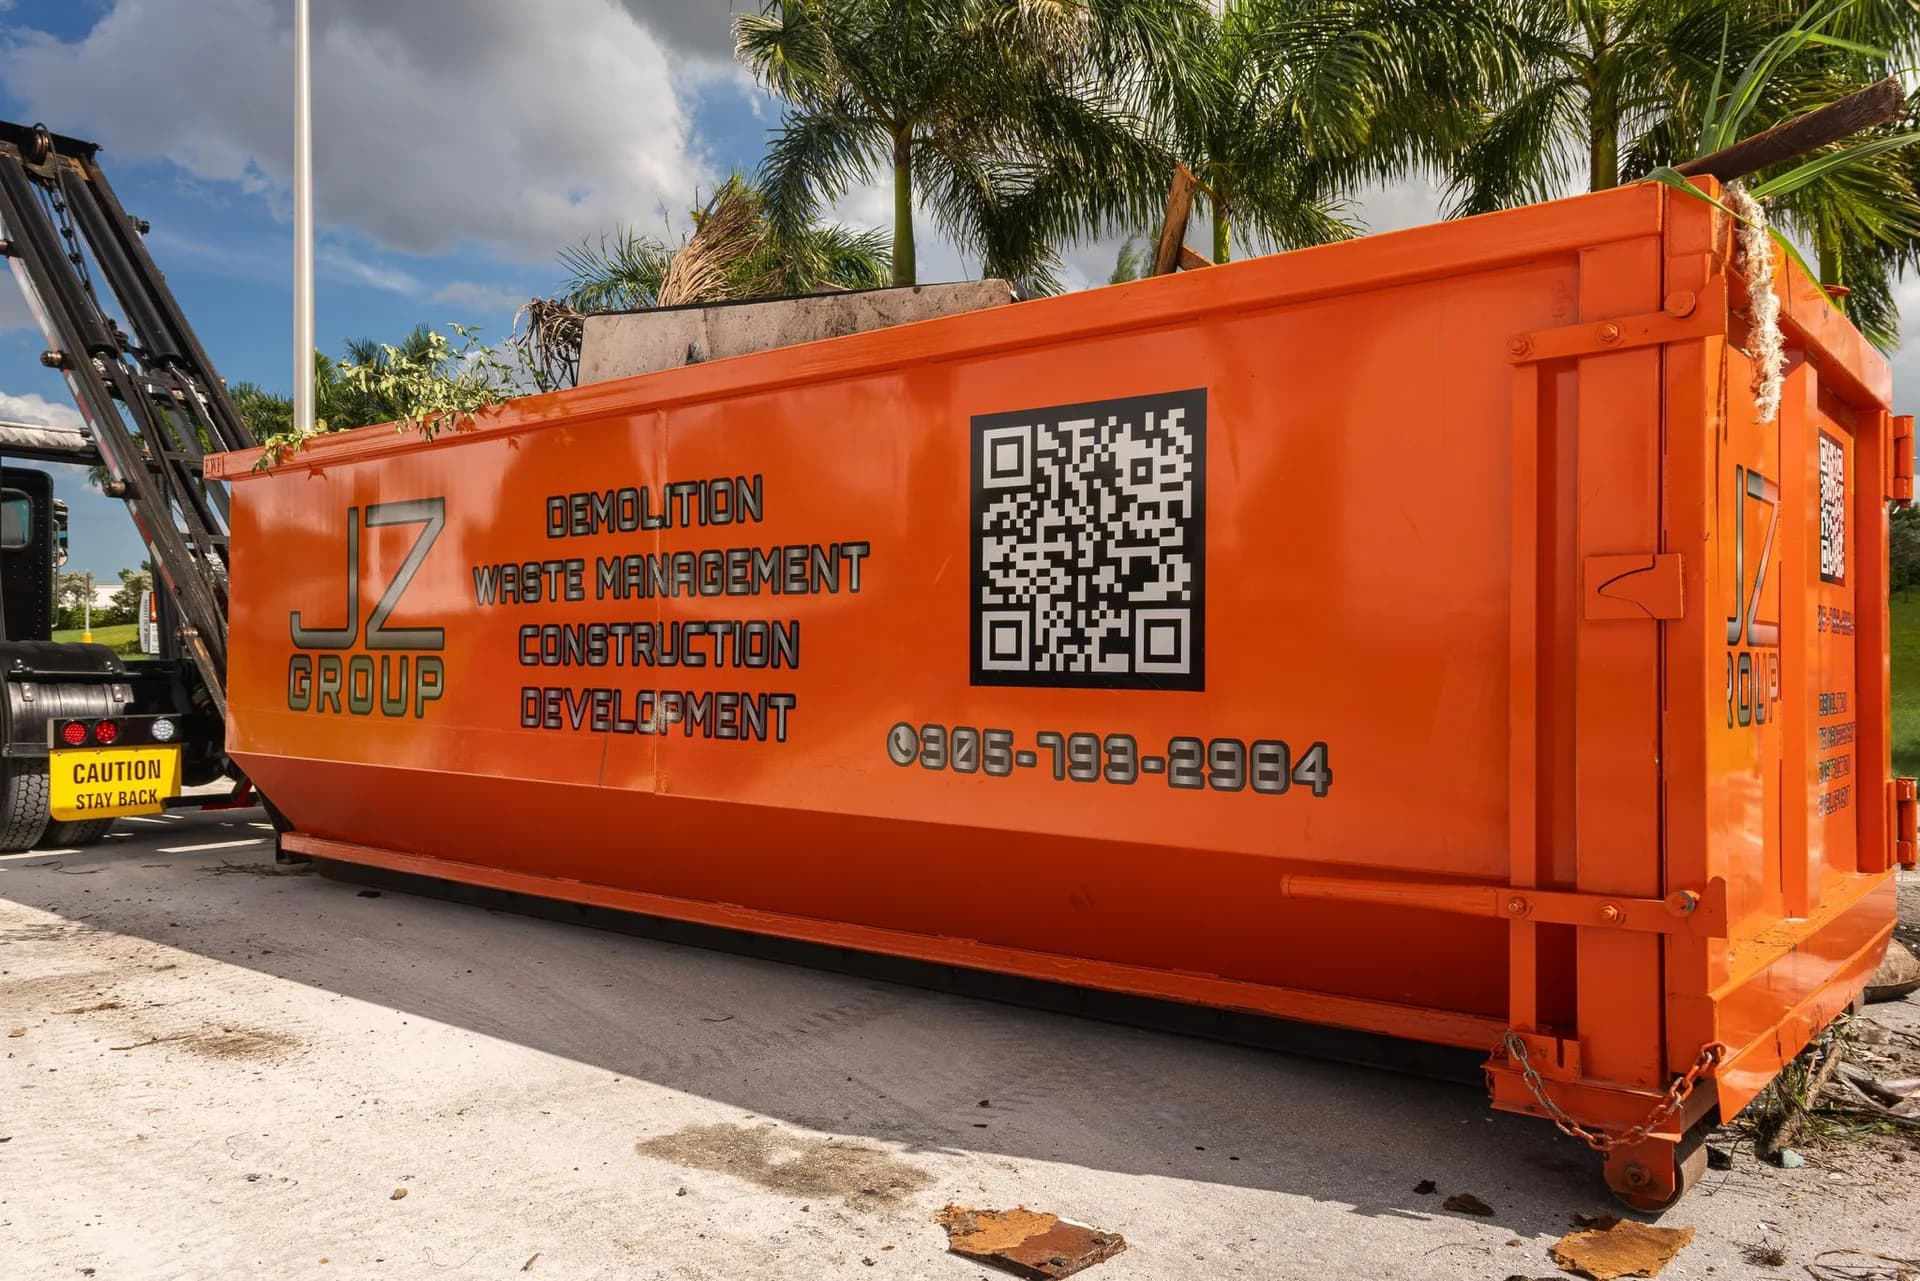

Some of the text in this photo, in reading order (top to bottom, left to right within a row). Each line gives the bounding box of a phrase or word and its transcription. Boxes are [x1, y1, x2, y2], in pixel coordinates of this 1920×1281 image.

[546, 474, 763, 538] DEMOLITION
[290, 496, 446, 650] JZ
[473, 541, 870, 606] WASTE MANAGEMENT
[518, 620, 800, 669] CONSTRUCTION
[287, 653, 445, 719] GROUP
[520, 686, 796, 742] DEVELOPMENT
[1727, 651, 1779, 729] OUP
[73, 759, 161, 784] CAUTION
[919, 723, 1333, 798] 305-793-2984
[76, 788, 158, 810] STAY BACK
